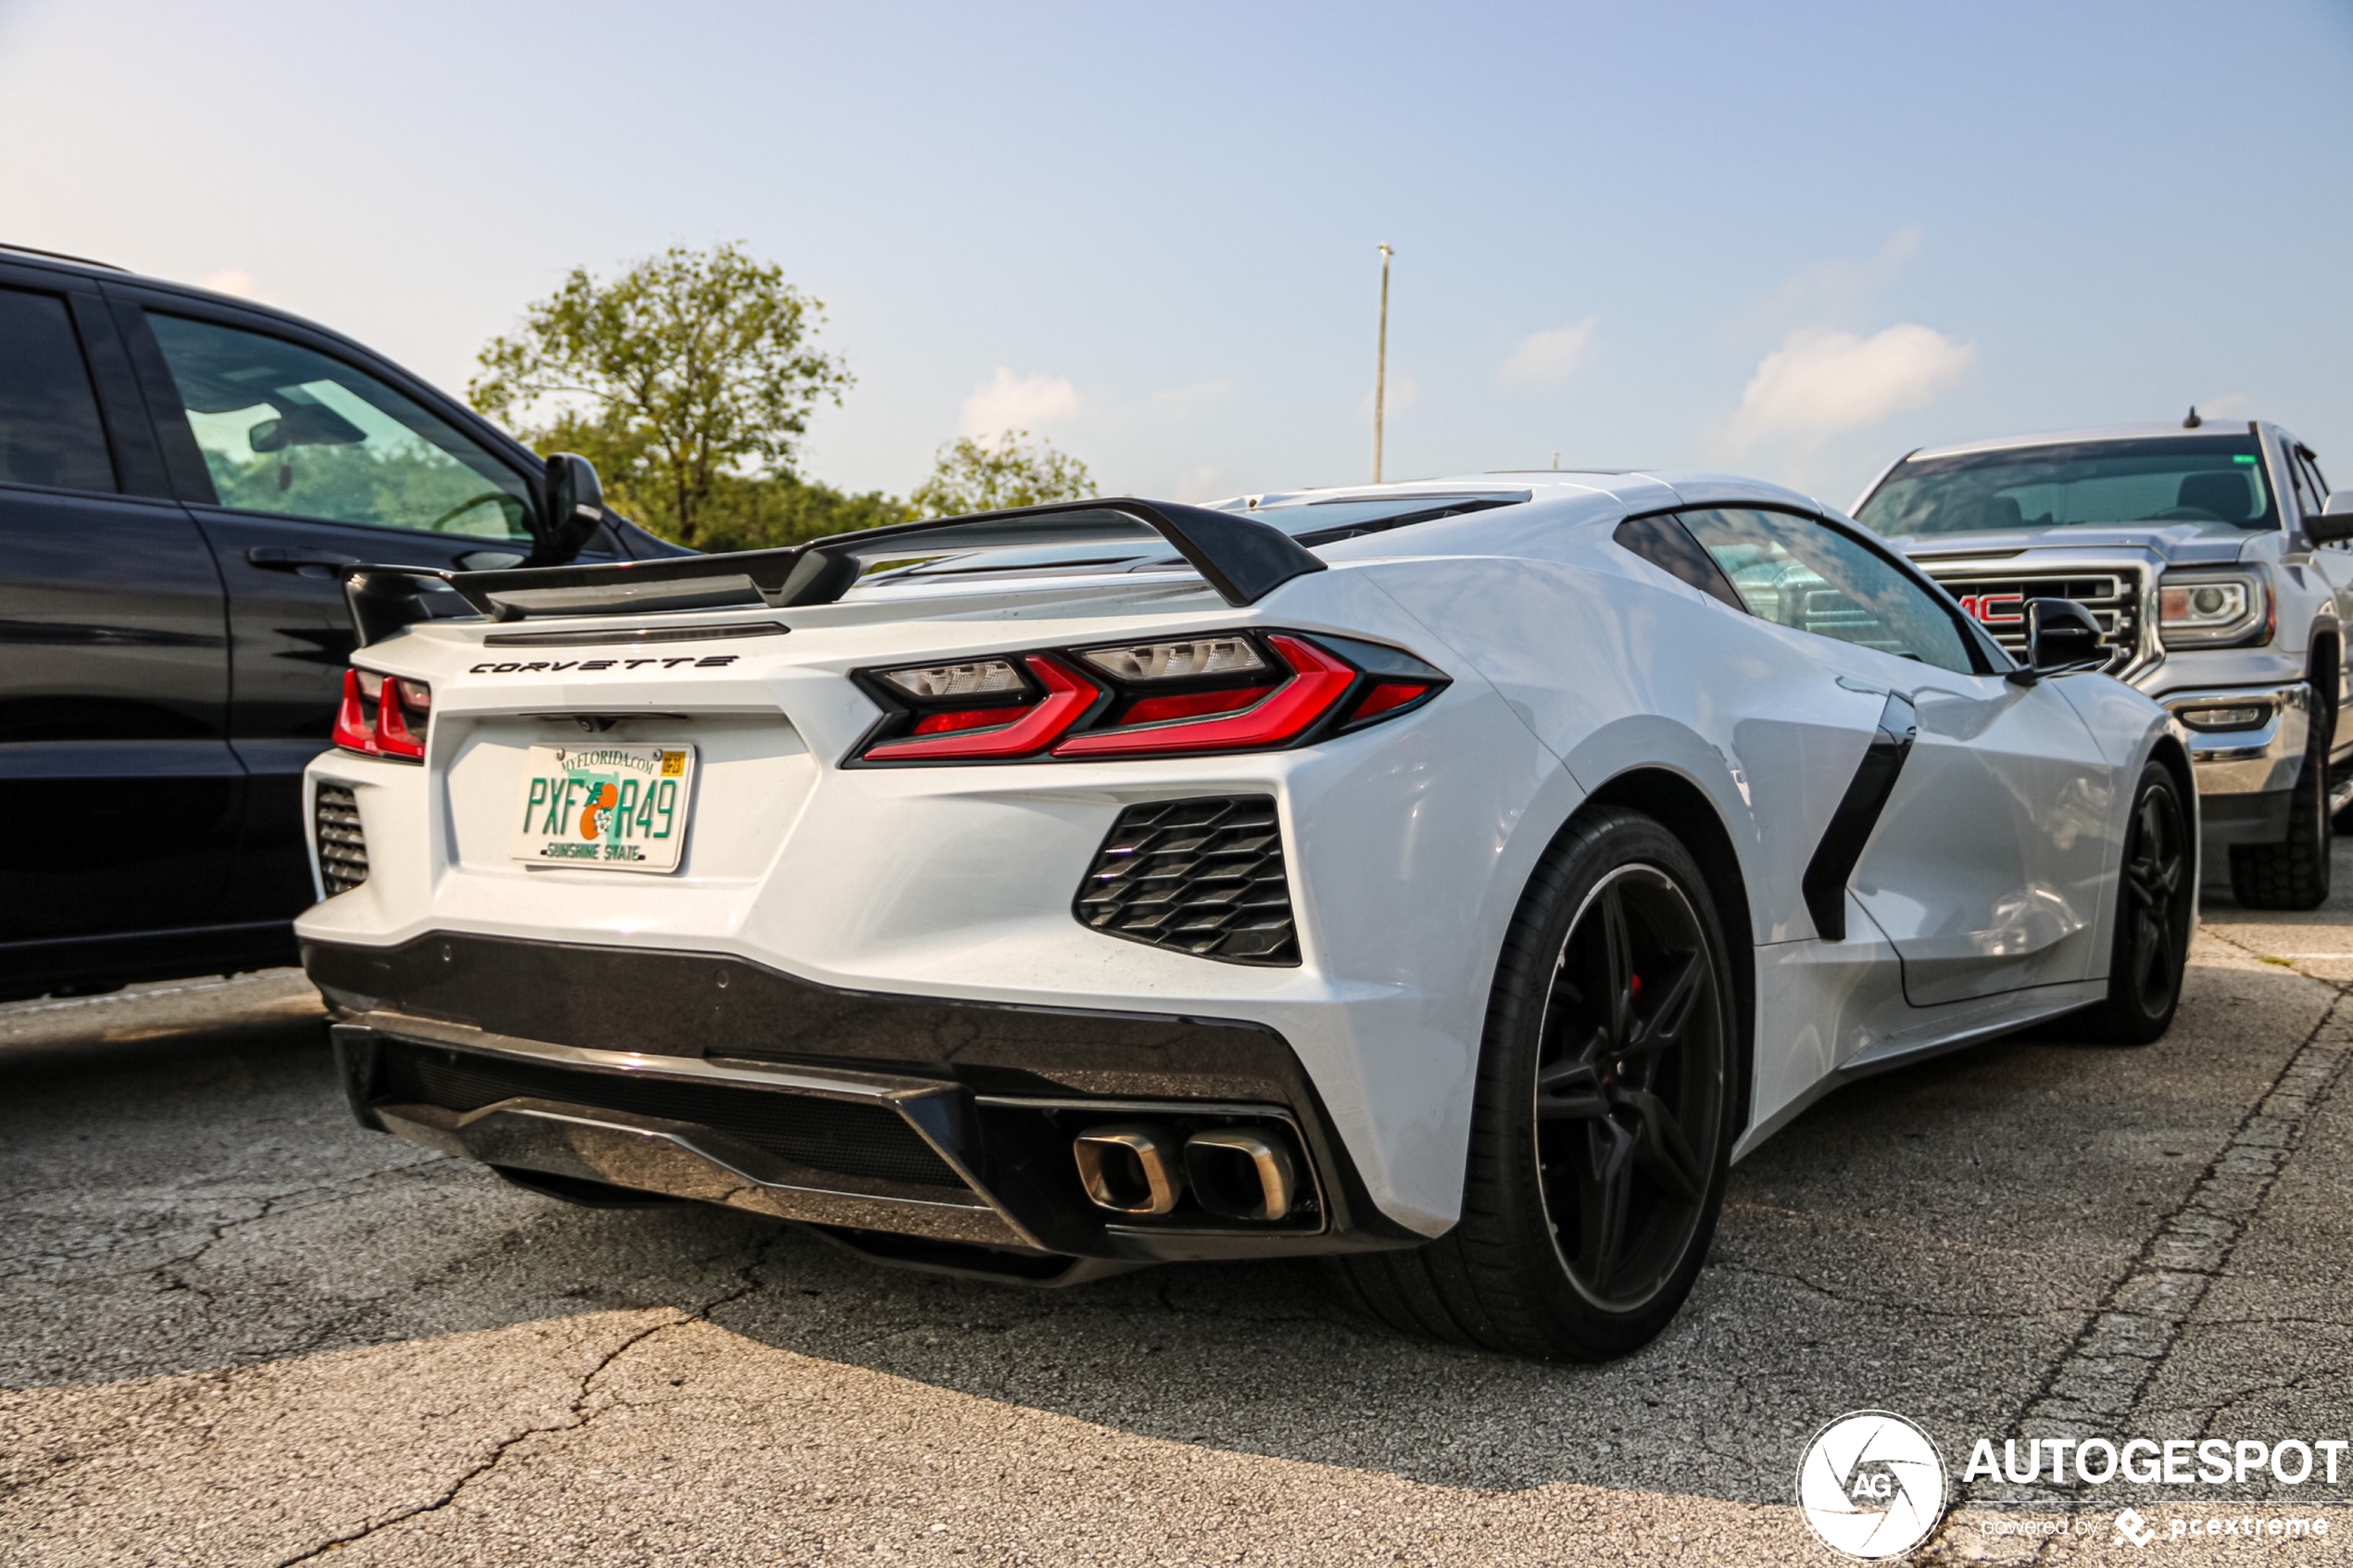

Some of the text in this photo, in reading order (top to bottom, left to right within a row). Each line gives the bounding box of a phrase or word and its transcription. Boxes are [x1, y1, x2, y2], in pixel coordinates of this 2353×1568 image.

[470, 656, 739, 673] CORVETTE
[560, 750, 654, 774] MYFLORIDA.COM
[522, 776, 677, 839] PXF R49
[546, 842, 640, 862] SUNSHINE STATE
